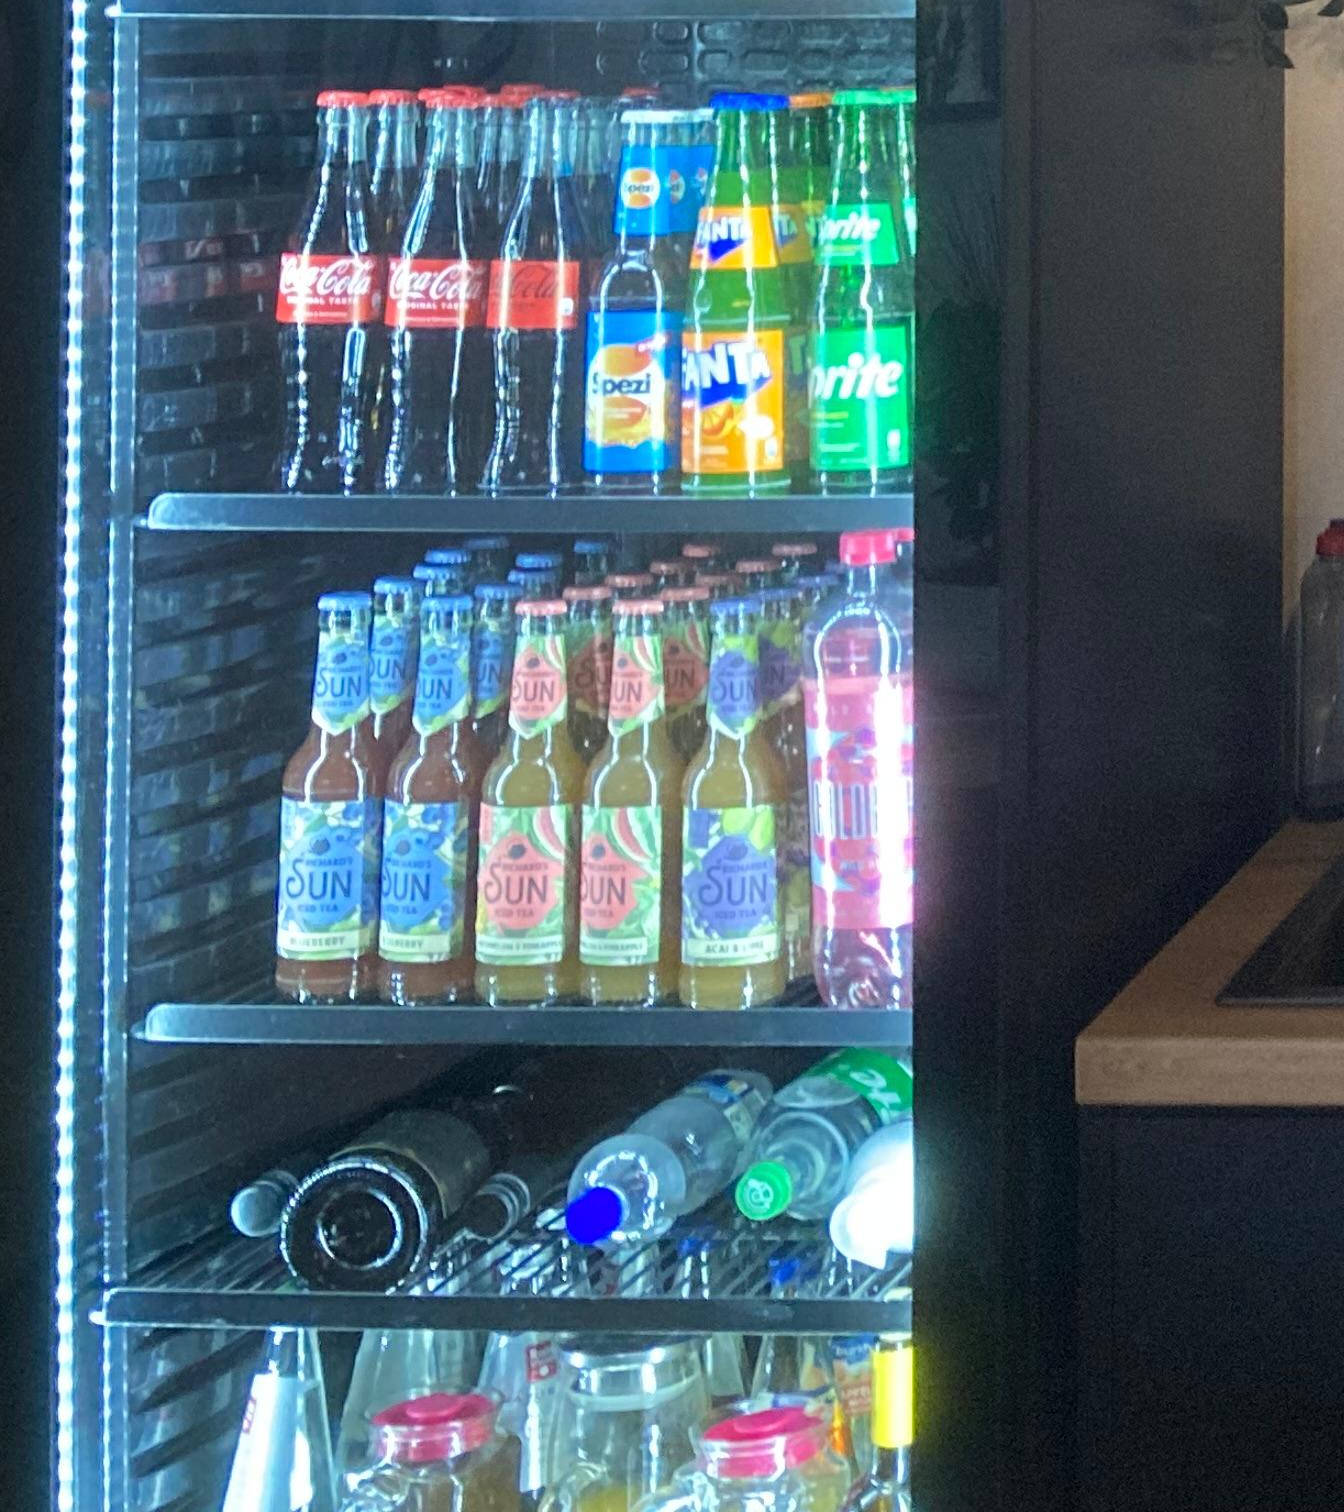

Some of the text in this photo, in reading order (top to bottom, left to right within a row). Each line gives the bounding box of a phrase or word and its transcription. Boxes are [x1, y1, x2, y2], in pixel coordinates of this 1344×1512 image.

[592, 372, 652, 396] Spezi
[286, 858, 352, 900] SUN
[484, 863, 548, 905] SUN
[698, 866, 768, 906] SUN
